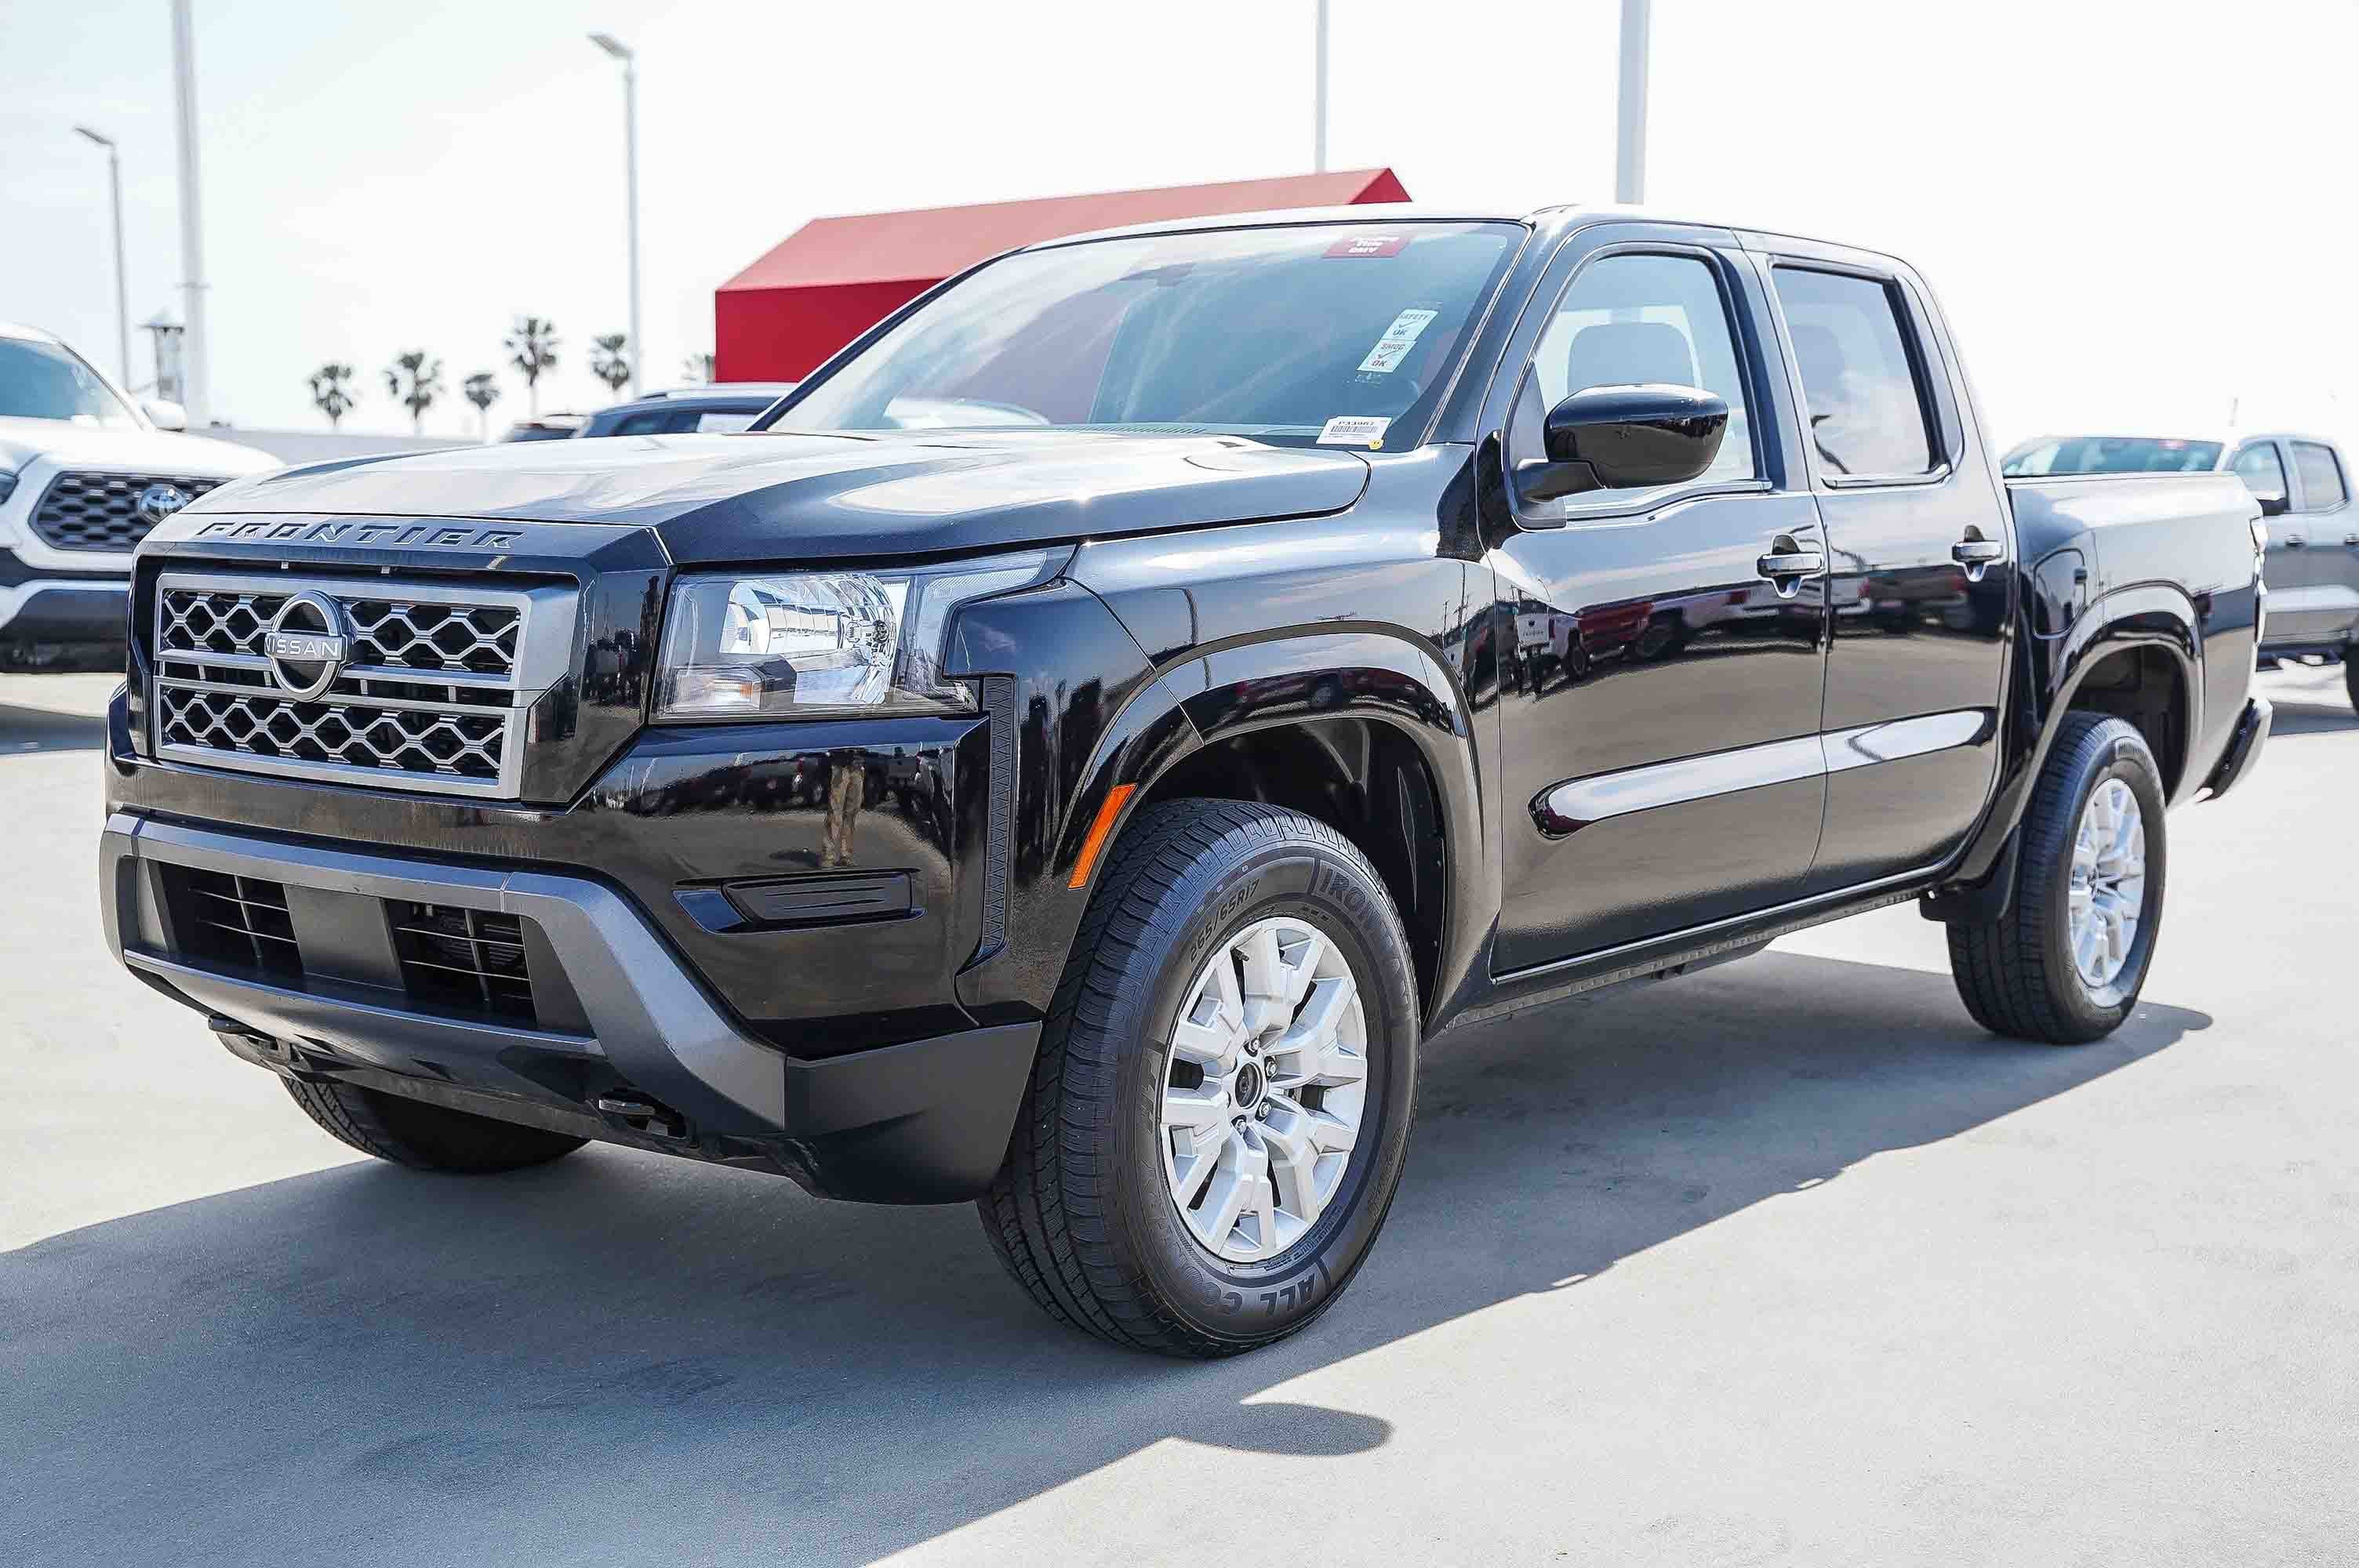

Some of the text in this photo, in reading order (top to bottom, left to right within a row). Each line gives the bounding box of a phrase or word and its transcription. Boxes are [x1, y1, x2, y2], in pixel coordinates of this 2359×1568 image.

[194, 521, 527, 548] FRONTIER
[265, 637, 339, 656] NISSAN
[1190, 877, 1261, 964] 265/65R17
[1259, 1272, 1316, 1317] ALL
